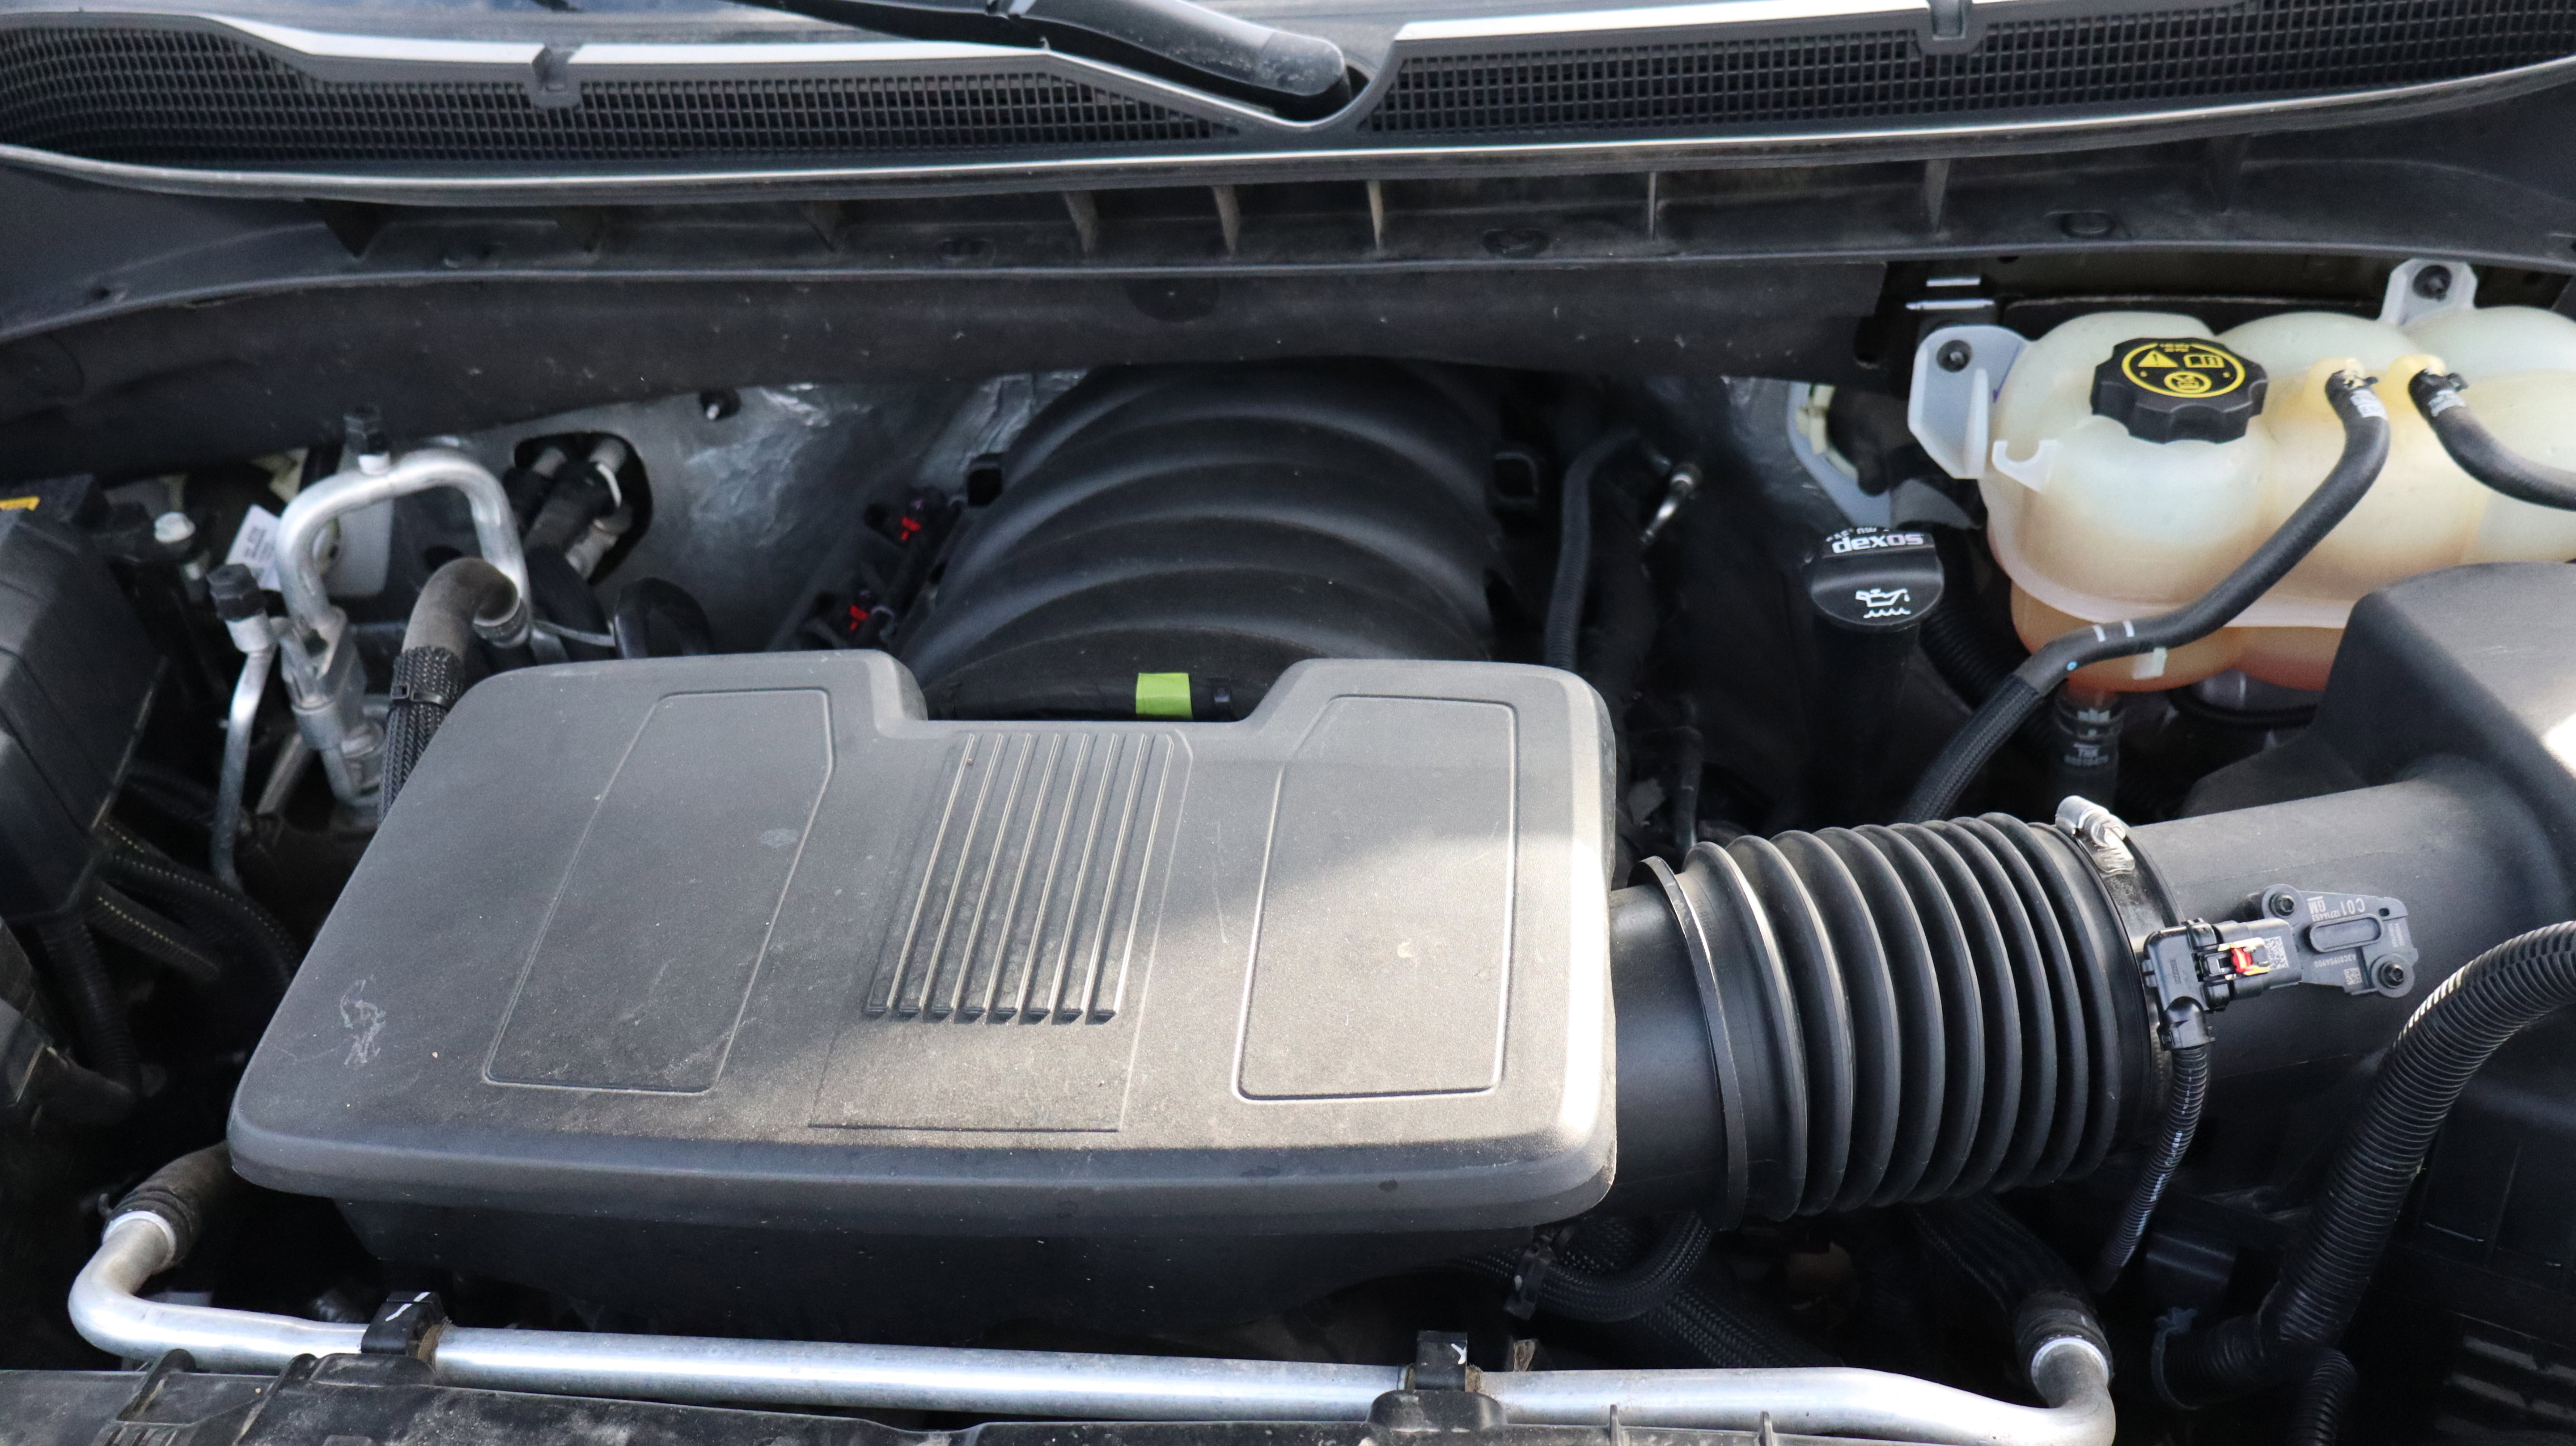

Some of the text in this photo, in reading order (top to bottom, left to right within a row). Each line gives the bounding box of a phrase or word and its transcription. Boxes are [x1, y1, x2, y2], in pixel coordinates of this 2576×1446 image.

[1832, 534, 1924, 553] dexos
[2308, 899, 2326, 914] GM
[2340, 897, 2365, 916] C01
